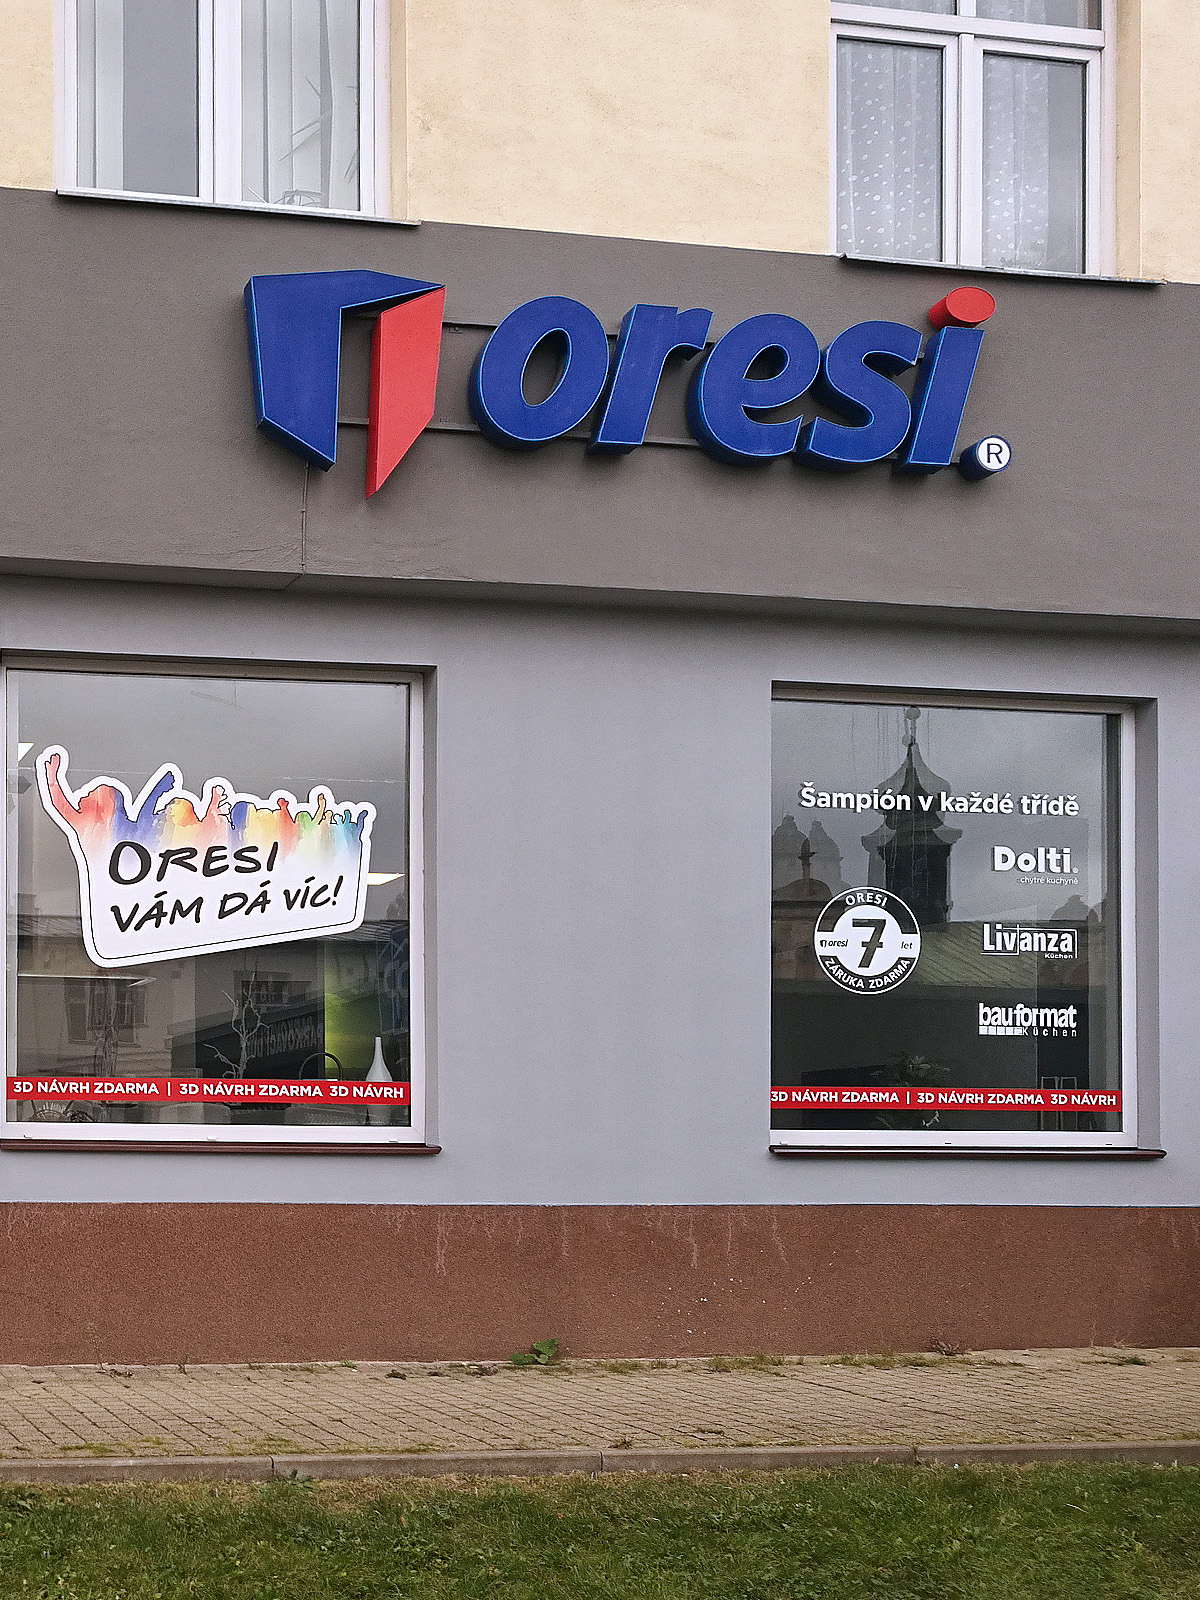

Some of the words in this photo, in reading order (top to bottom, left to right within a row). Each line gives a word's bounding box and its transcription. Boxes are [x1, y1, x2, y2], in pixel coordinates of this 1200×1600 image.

[470, 285, 997, 476] oresi
[800, 781, 911, 813] Šampión
[918, 795, 934, 811] v
[940, 791, 1014, 814] každé
[1021, 794, 1080, 816] třídě
[108, 841, 279, 885] ORESI
[994, 846, 1071, 873] Dolti
[1020, 876, 1044, 885] chytré
[110, 890, 204, 933] VÁM
[218, 880, 271, 920] DÁ
[845, 892, 888, 906] ORESI
[828, 939, 849, 948] oresi
[852, 918, 887, 969] 7
[900, 941, 913, 949] let
[824, 958, 865, 989] ZÁRUKA
[868, 959, 911, 989] ZDARMA
[1022, 1027, 1078, 1038] Küchen
[13, 1082, 34, 1094] 3D
[37, 1079, 90, 1094] NÁVRH
[94, 1082, 160, 1095] ZDARMA
[179, 1083, 200, 1096] 3D
[203, 1081, 255, 1097] NÁVRH
[258, 1085, 323, 1098] ZDARMA
[329, 1085, 349, 1099] 3D
[352, 1083, 404, 1100] NÁVRH
[770, 1090, 789, 1103] 3D
[791, 1089, 839, 1103] NÁVRH
[841, 1091, 900, 1103] ZDARMA
[917, 1092, 936, 1104] 3D
[938, 1090, 985, 1105] NÁVRH
[987, 1093, 1045, 1106] ZDARMA
[1050, 1093, 1068, 1106] 3D
[1071, 1091, 1117, 1107] NÁVRH
